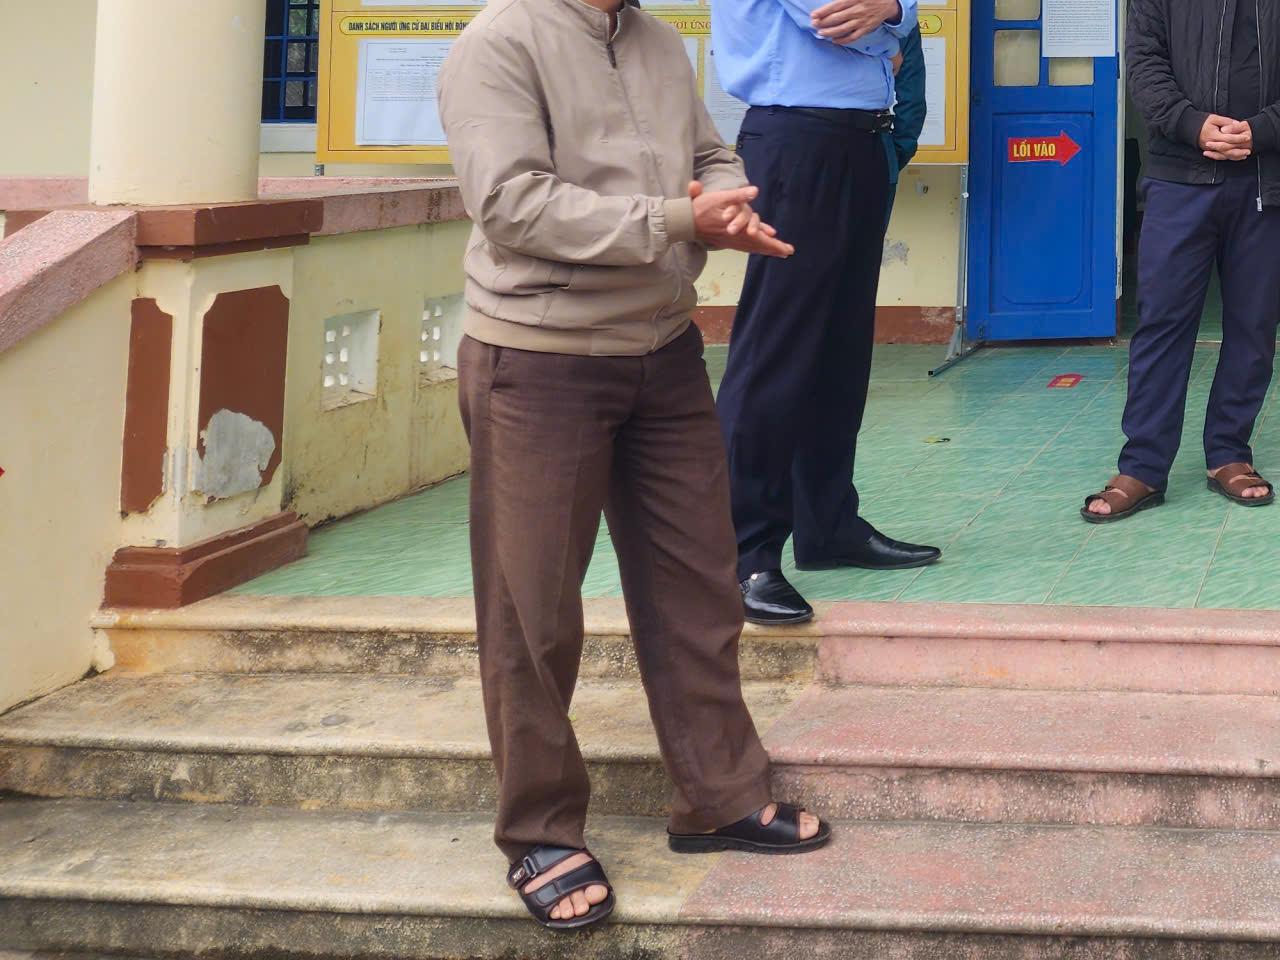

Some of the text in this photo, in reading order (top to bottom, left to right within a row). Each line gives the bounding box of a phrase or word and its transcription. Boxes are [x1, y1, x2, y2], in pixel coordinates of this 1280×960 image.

[455, 20, 469, 30] ĐỒN
[1013, 139, 1056, 157] LỐI VÀO
